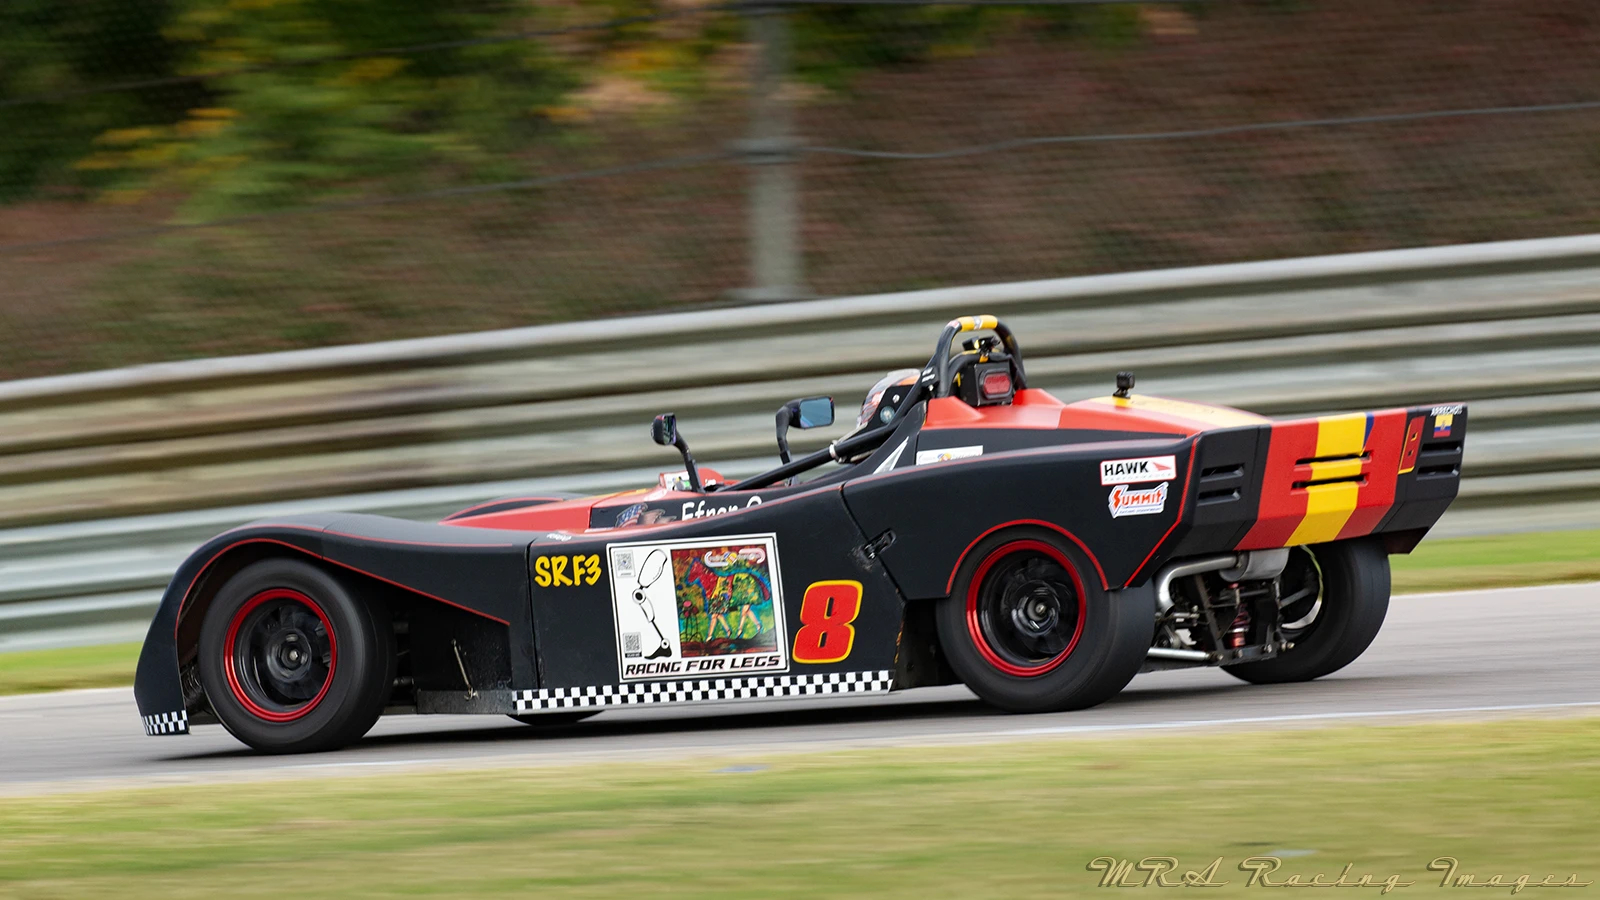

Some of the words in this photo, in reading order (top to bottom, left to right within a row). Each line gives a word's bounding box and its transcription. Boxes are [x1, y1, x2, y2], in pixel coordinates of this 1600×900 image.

[1104, 461, 1149, 476] HAWK
[534, 554, 602, 587] SRF3
[792, 580, 863, 664] 8
[625, 661, 682, 676] RACING
[685, 658, 725, 672] FOR
[729, 655, 781, 669] LEGS
